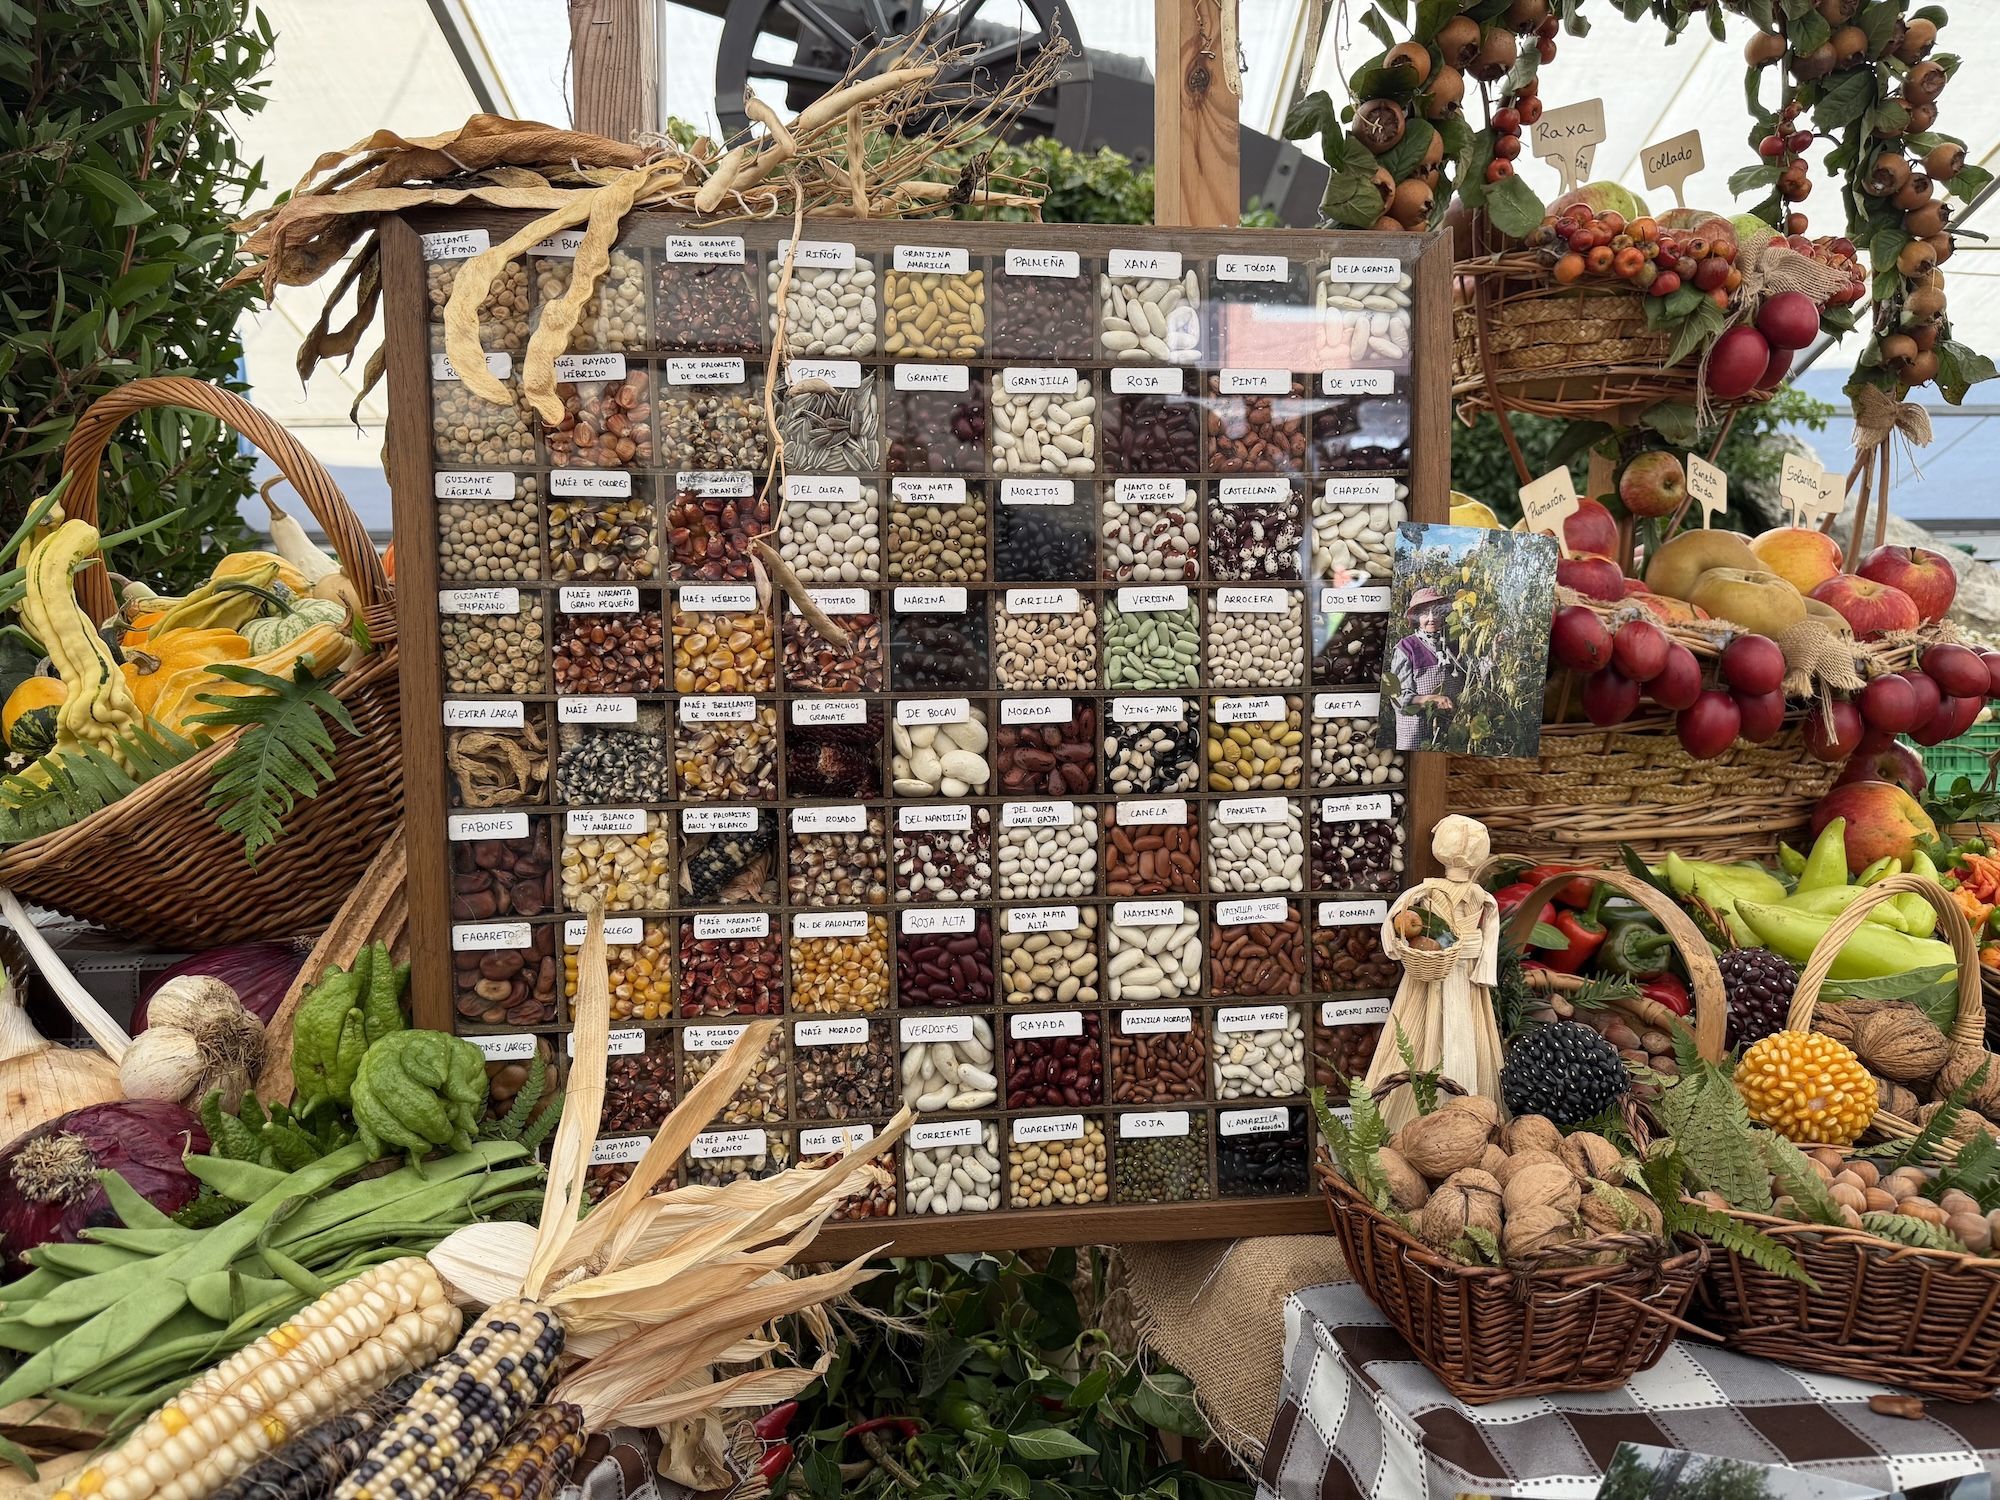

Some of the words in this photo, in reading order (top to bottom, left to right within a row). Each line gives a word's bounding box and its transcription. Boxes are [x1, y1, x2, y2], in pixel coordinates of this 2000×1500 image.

[1536, 122, 1594, 142] Raxa
[1648, 147, 1693, 174] Collado
[672, 239, 692, 247] MAÍZ
[704, 249, 741, 258] PEQUEÑO
[806, 248, 841, 259] RIÑÓN
[903, 250, 951, 258] GRANJINA
[907, 261, 950, 269] AMARILLA
[1013, 255, 1064, 267] PALMEÑA
[1125, 260, 1157, 269] XANA
[1226, 264, 1236, 272] DE
[1244, 264, 1275, 272] TOLOSA
[582, 357, 616, 365] RAYADO
[564, 369, 606, 379] HÍBRIDO
[798, 368, 836, 381] PIPAS
[907, 373, 948, 382] GRANATE
[1012, 376, 1068, 386] GRANJILLA
[1127, 376, 1158, 387] ROJA
[1232, 376, 1266, 386] PINTA
[1331, 379, 1342, 388] DE
[1350, 379, 1377, 387] VINO
[445, 476, 494, 484] GUISANTE
[555, 477, 577, 487] MAÍZ
[599, 480, 627, 488] COLORES
[791, 485, 812, 495] DEL
[898, 482, 922, 490] ROXA
[1123, 484, 1153, 492] MANTO
[1333, 483, 1379, 495] CHAPLÓN
[445, 486, 491, 496] LÁGRIMA
[1011, 487, 1058, 496] MORITOS
[1224, 487, 1276, 495] CASTELLANA
[911, 493, 934, 501] BAJA
[1527, 487, 1567, 519] Pumarón
[567, 589, 590, 598] MAÍZ
[682, 595, 705, 603] MAÍZ
[712, 594, 750, 602] HÍBRIDO
[821, 597, 855, 605] TOSTADO
[904, 595, 945, 604] MARINA
[1015, 595, 1063, 605] CARILLA
[1133, 595, 1174, 605] VERDINA
[1225, 595, 1273, 603] ARROCERA
[1327, 596, 1344, 604] OJO
[571, 601, 595, 609] GRANO
[599, 598, 634, 608] PEQUEÑO
[566, 705, 587, 714] MAÍZ
[596, 703, 622, 712] AZUL
[684, 701, 706, 709] MAÍZ
[712, 701, 753, 709] BRILLANTE
[1325, 700, 1361, 709] CARETA
[458, 709, 486, 719] EXTRA
[490, 709, 518, 718] LARGA
[905, 709, 920, 718] DE
[927, 708, 956, 717] BOCAU
[1008, 707, 1051, 716] MORADA
[1122, 705, 1177, 715] YING-YANG
[810, 713, 845, 721] GRANATE
[1012, 806, 1028, 814] DEL
[1131, 808, 1167, 817] CANELA
[1227, 807, 1266, 815] PANCHETA
[1328, 804, 1350, 813] PINTA
[573, 812, 593, 822] MAÍZ
[600, 813, 634, 821] BLANCO
[798, 813, 816, 822] MAÍZ
[905, 815, 922, 824] DEL
[925, 810, 967, 822] MANDILÍN
[461, 821, 512, 833] FABONES
[1124, 908, 1173, 918] MAXIMINA
[1221, 905, 1252, 916] VAINILLA
[1258, 903, 1279, 911] VERDE
[1340, 909, 1375, 917] ROMANA
[699, 916, 720, 925] MAÍZ
[726, 915, 761, 924] NARANJA
[1014, 912, 1037, 920] ROXA
[911, 916, 938, 928] ROJA
[942, 916, 965, 926] ALTA
[1028, 921, 1048, 929] ALTA
[729, 925, 762, 934] GRANDE
[1126, 1017, 1160, 1025] VAINILLA
[1222, 1014, 1255, 1022] VAINILLA
[1018, 1020, 1064, 1031] RAYADA
[801, 1025, 821, 1036] MAÍZ
[908, 1025, 958, 1036] VERDOSAS
[504, 1042, 532, 1052] LARGES
[1235, 1114, 1278, 1126] AMARILLA
[1020, 1122, 1077, 1134] CUARENTINA
[917, 1128, 970, 1140] CORRIENTE
[697, 1135, 718, 1144] MAÍZ
[727, 1134, 749, 1142] AZUL
[806, 1134, 826, 1145] MAÍZ
[606, 1141, 640, 1150] RAYADO
[712, 1146, 742, 1154] BLANCO
[595, 1152, 627, 1161] GALLEGO
